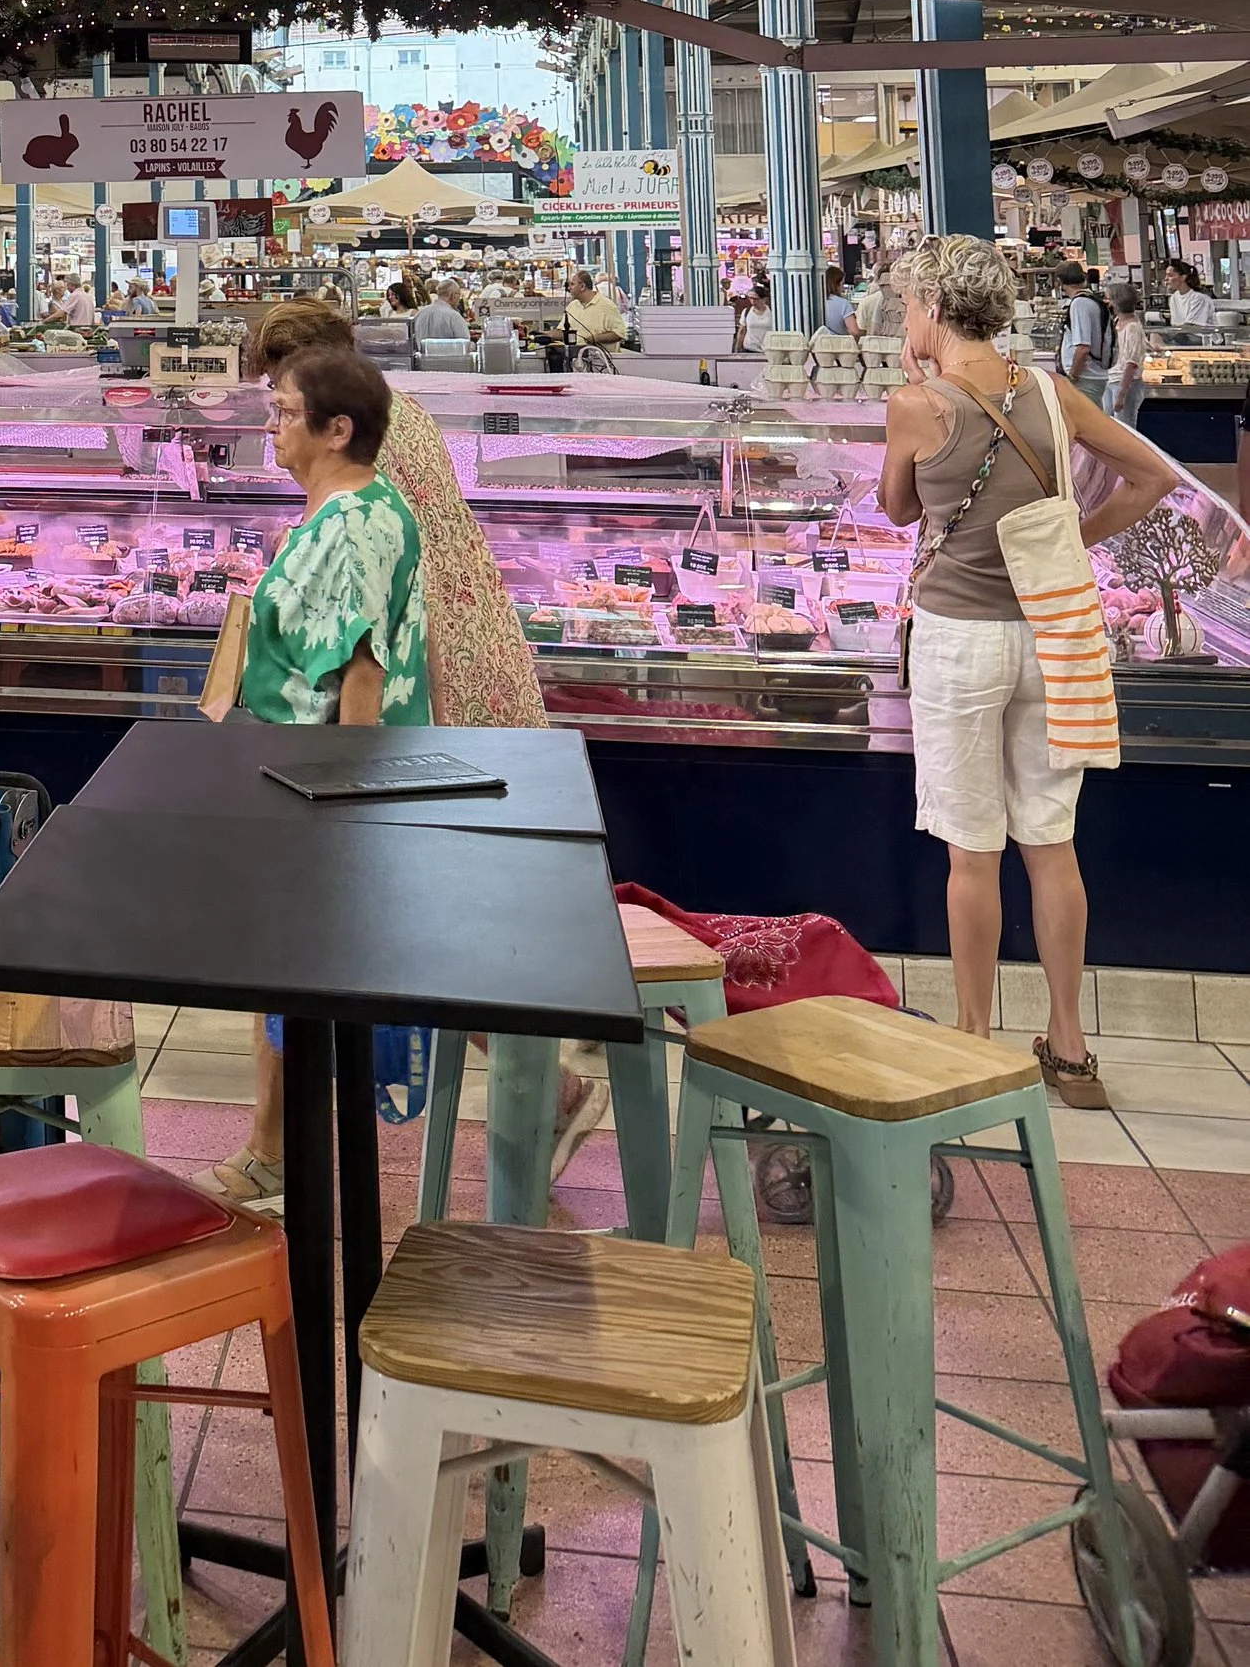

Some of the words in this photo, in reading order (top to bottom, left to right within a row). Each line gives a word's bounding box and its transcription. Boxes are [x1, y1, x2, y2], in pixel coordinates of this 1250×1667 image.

[143, 103, 212, 123] RACHEL
[147, 124, 170, 132] MAISON
[130, 139, 146, 153] 03
[150, 138, 167, 153] 80
[171, 137, 187, 152] 54
[191, 137, 208, 152] 22
[213, 137, 228, 152] 17
[145, 162, 171, 173] LAPINS
[177, 161, 216, 172] VOLAILLES
[582, 177, 614, 195] Miel
[542, 202, 582, 211] CICEKLI
[624, 201, 678, 210] PRIMEURS
